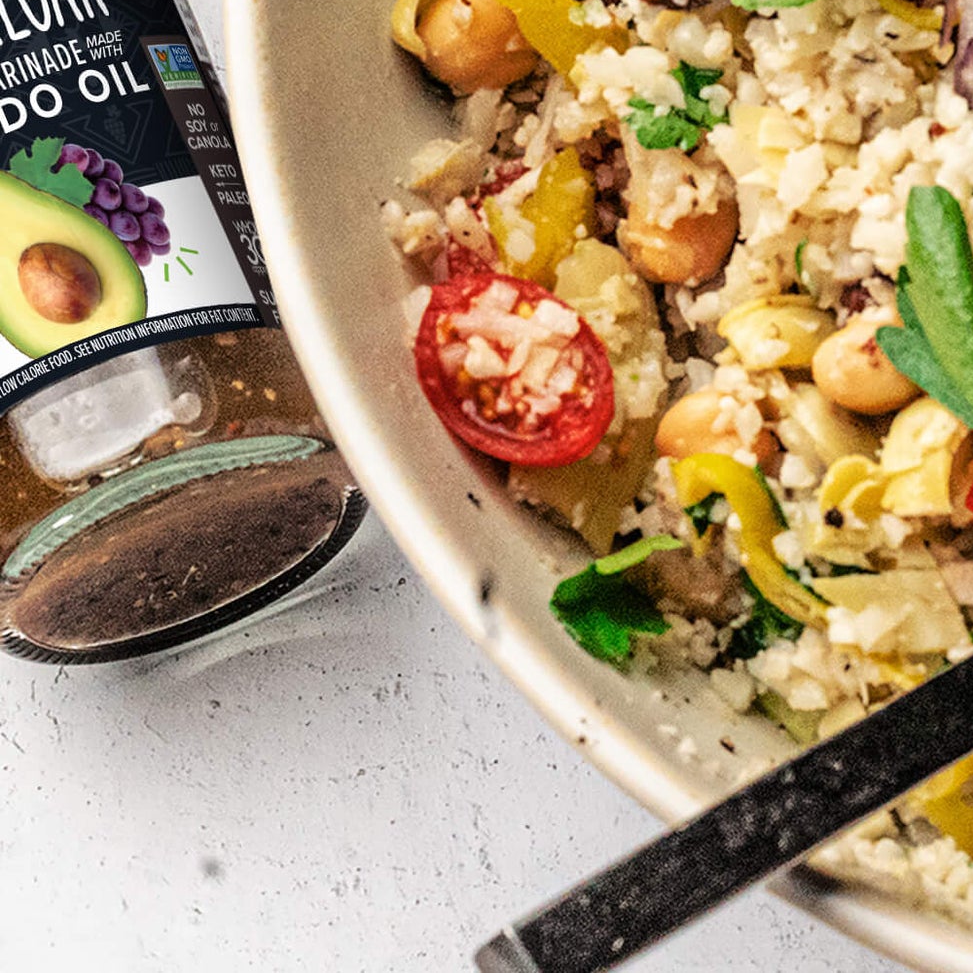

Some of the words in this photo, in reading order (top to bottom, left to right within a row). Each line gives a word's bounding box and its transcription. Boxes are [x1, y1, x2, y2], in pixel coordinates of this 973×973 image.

[86, 30, 122, 48] MADE
[90, 44, 123, 61] WITH
[171, 47, 188, 56] NON
[175, 55, 192, 63] GMO
[78, 61, 150, 103] OIL
[186, 103, 205, 117] NO
[185, 118, 208, 133] SOY
[187, 134, 232, 150] CANOLA
[208, 163, 237, 178] KETO
[217, 190, 250, 205] PALEO
[0, 375, 19, 398] LOW
[16, 358, 51, 387] CALORIE
[47, 348, 77, 371] FOOD.
[73, 340, 93, 359] SEE
[89, 326, 138, 353] NUTRITION
[135, 311, 193, 339] INFORMATION
[191, 309, 211, 326] FOR
[208, 308, 225, 325] FAT
